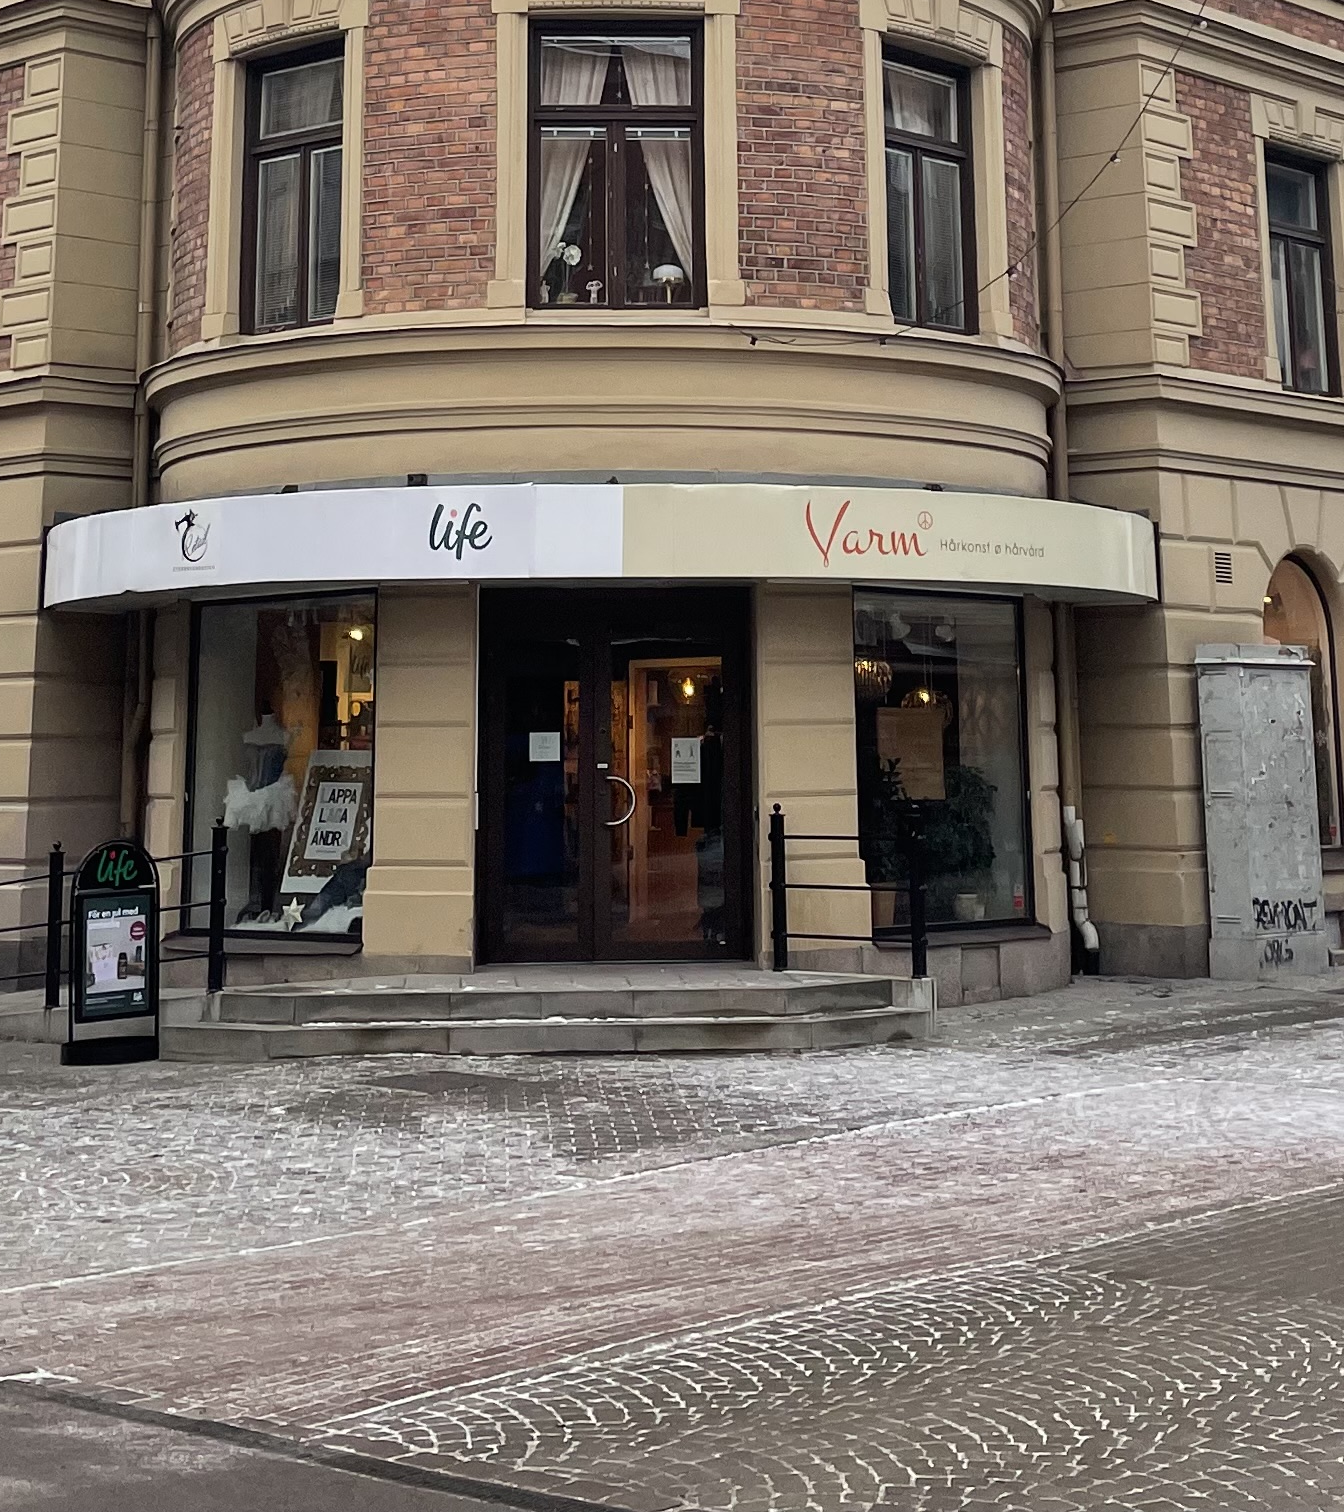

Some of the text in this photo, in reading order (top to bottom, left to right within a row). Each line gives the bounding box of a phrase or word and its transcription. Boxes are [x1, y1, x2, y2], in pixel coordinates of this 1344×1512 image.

[429, 503, 493, 560] life
[805, 499, 928, 568] Varm
[940, 538, 991, 554] Hårkonst
[97, 849, 138, 887] life
